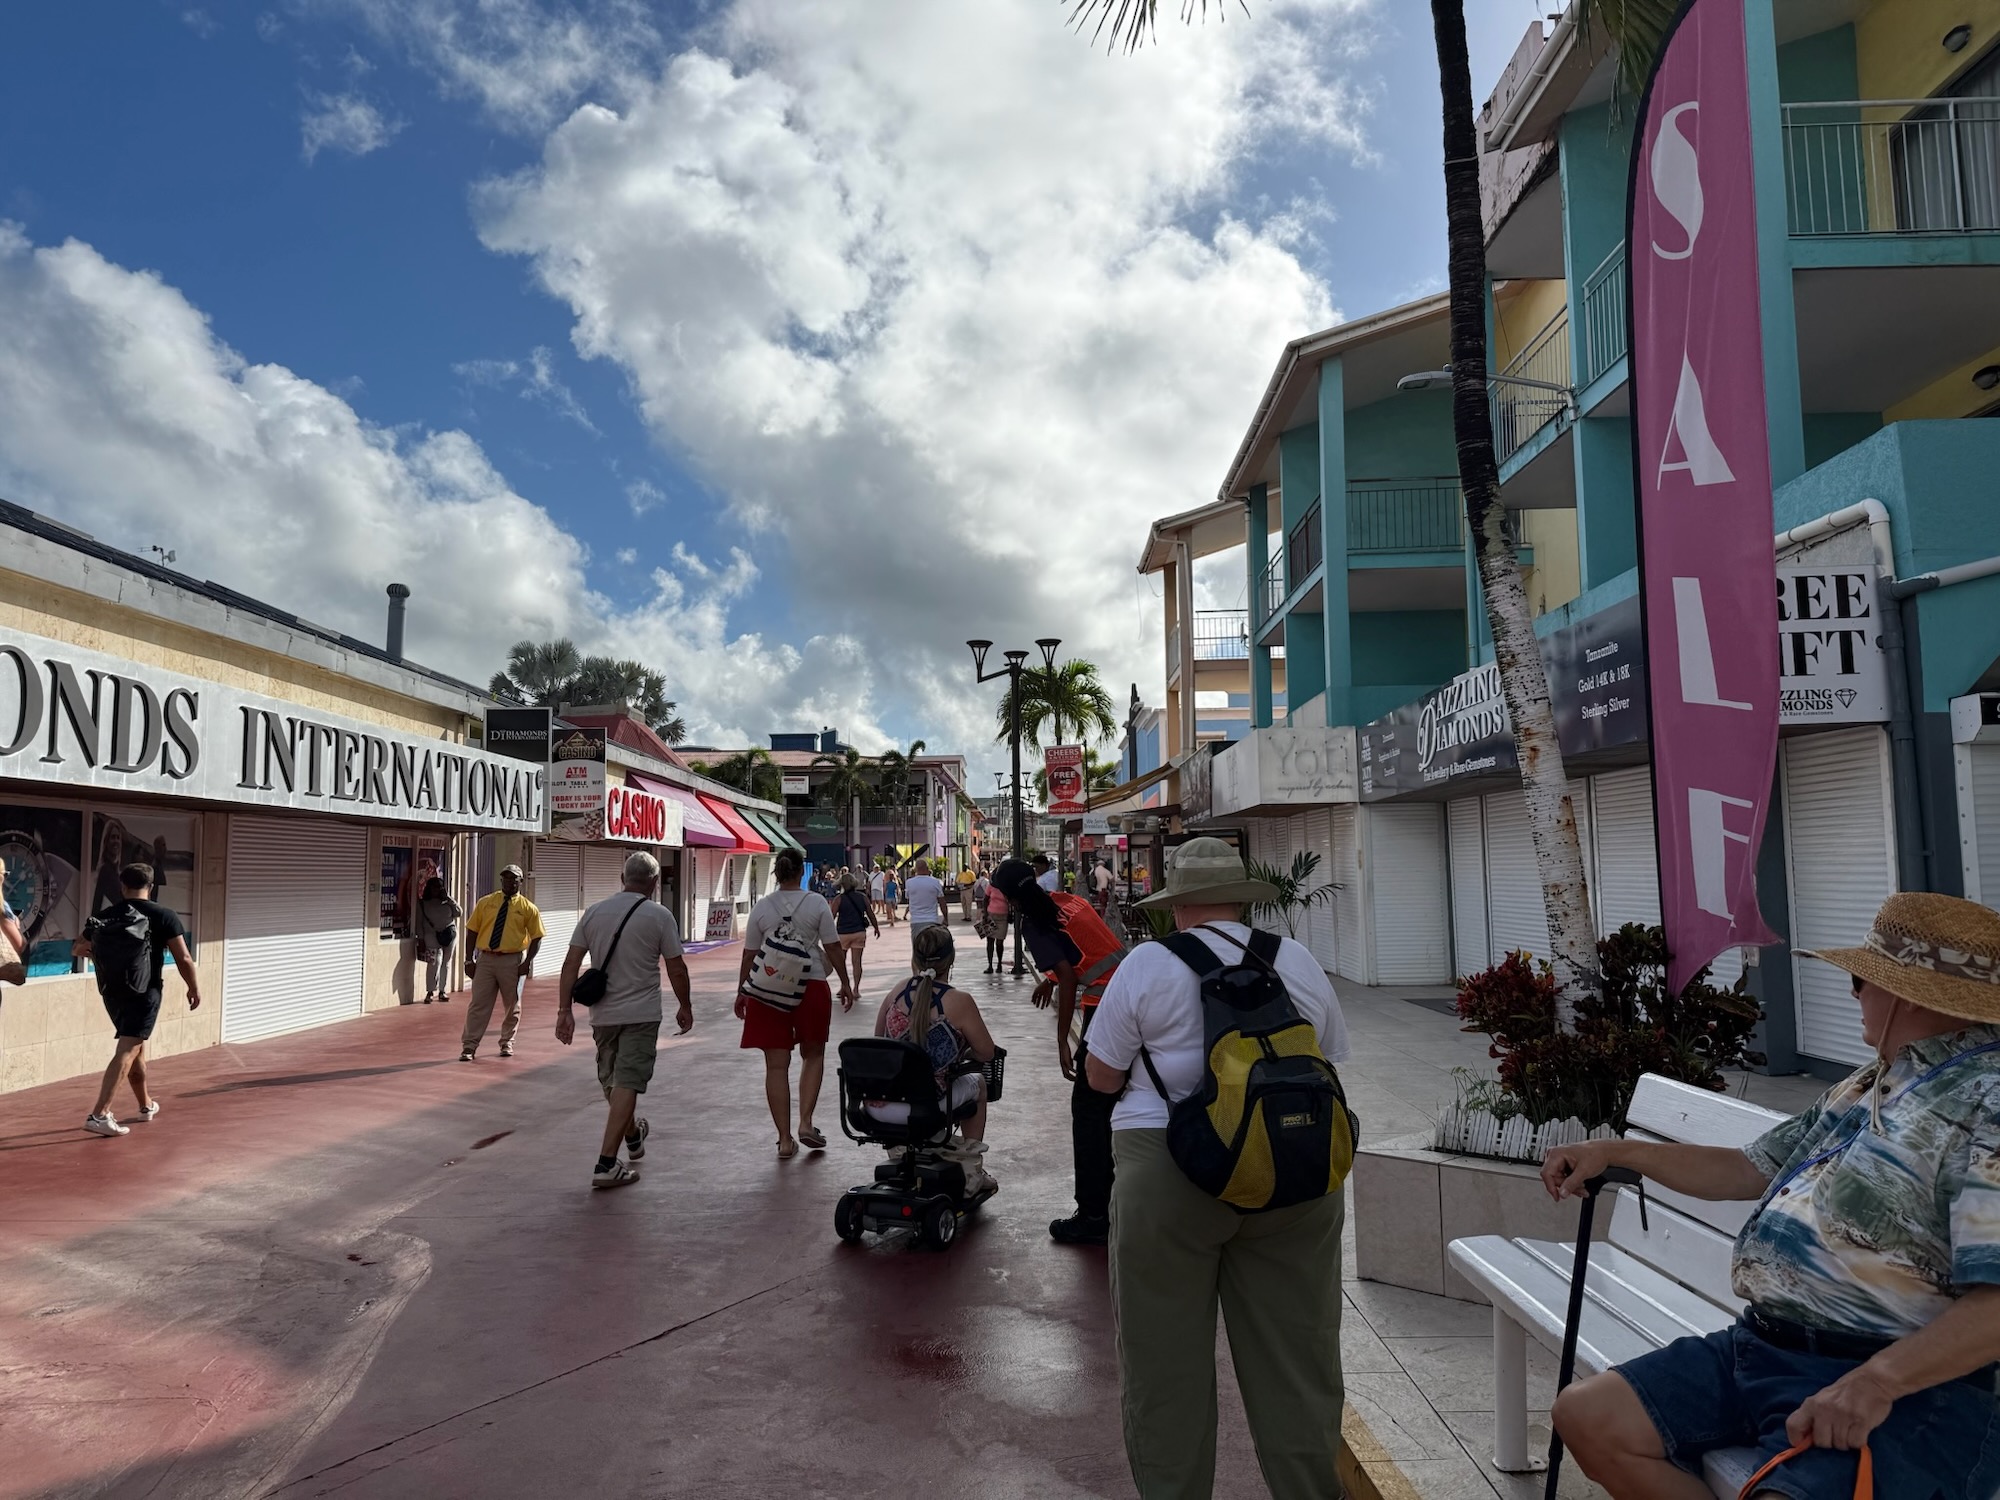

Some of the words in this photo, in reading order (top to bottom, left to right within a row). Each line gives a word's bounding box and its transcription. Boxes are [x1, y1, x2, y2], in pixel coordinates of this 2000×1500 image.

[1650, 101, 1753, 925] SALE
[1578, 675, 1595, 693] Gold
[1595, 671, 1609, 688] 14K
[1609, 669, 1616, 683] &
[1617, 663, 1631, 681] 18K
[1581, 702, 1608, 719] Sterling
[1609, 697, 1630, 713] Silver
[559, 746, 597, 759] CASINO
[1047, 748, 1080, 757] CHEERS
[566, 767, 587, 775] ATM
[1053, 771, 1076, 779] FREE
[608, 787, 667, 842] CASINO
[712, 909, 731, 919] 10%
[708, 917, 728, 925] OFF
